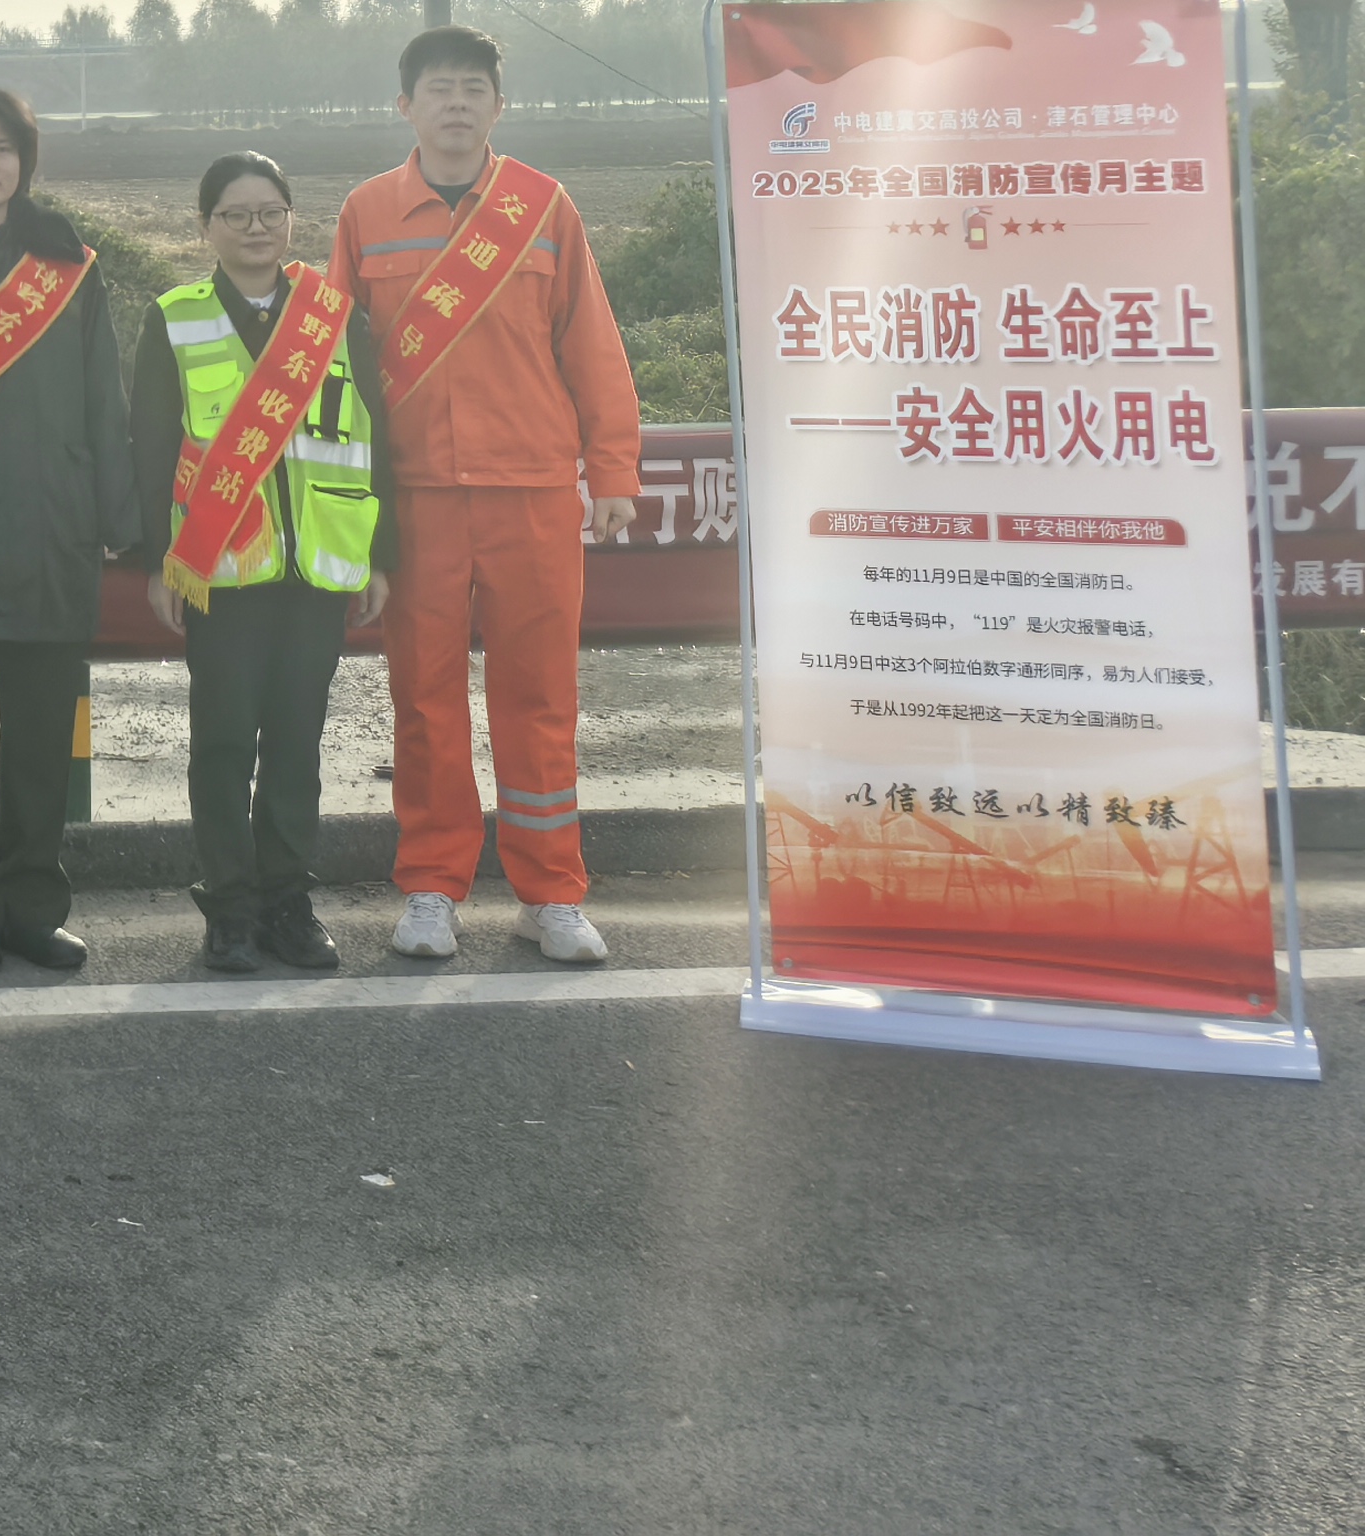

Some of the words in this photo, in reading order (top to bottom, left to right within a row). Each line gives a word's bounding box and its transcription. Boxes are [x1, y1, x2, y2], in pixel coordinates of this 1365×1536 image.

[753, 159, 1206, 199] 2025年全国消防宣传月主题
[775, 287, 978, 362] 全民消防
[1000, 285, 1215, 360] 生命至上
[827, 511, 974, 537] 消防宣传进万家
[1011, 517, 1165, 542] 平安相伴你我他
[863, 564, 1135, 592] 每年的11月9日是中国的全国消防日。
[849, 699, 1165, 732] 于是从1992年起把这一天定为全国消防日。
